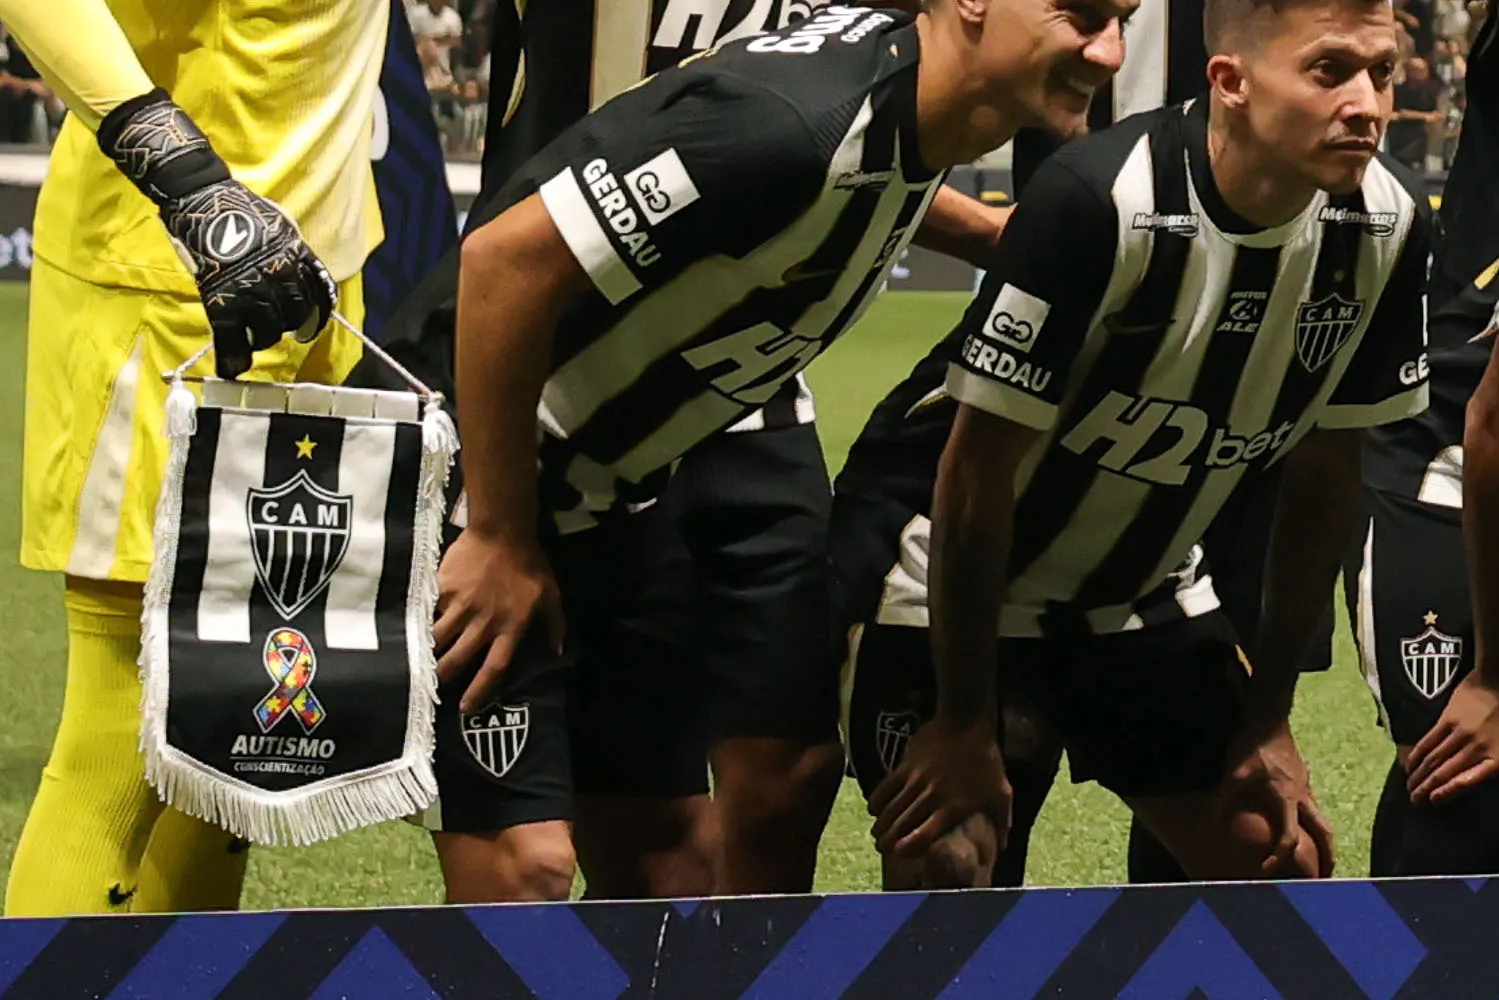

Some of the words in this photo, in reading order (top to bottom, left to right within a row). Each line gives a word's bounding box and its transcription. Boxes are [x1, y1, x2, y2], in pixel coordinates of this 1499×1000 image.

[582, 157, 662, 268] GERDAU
[1306, 305, 1354, 322] CAM
[1060, 389, 1294, 487] H2bet
[261, 501, 340, 528] CAM
[1408, 641, 1456, 656] CAM
[469, 712, 521, 728] CAM
[231, 735, 336, 760] AUTISMO
